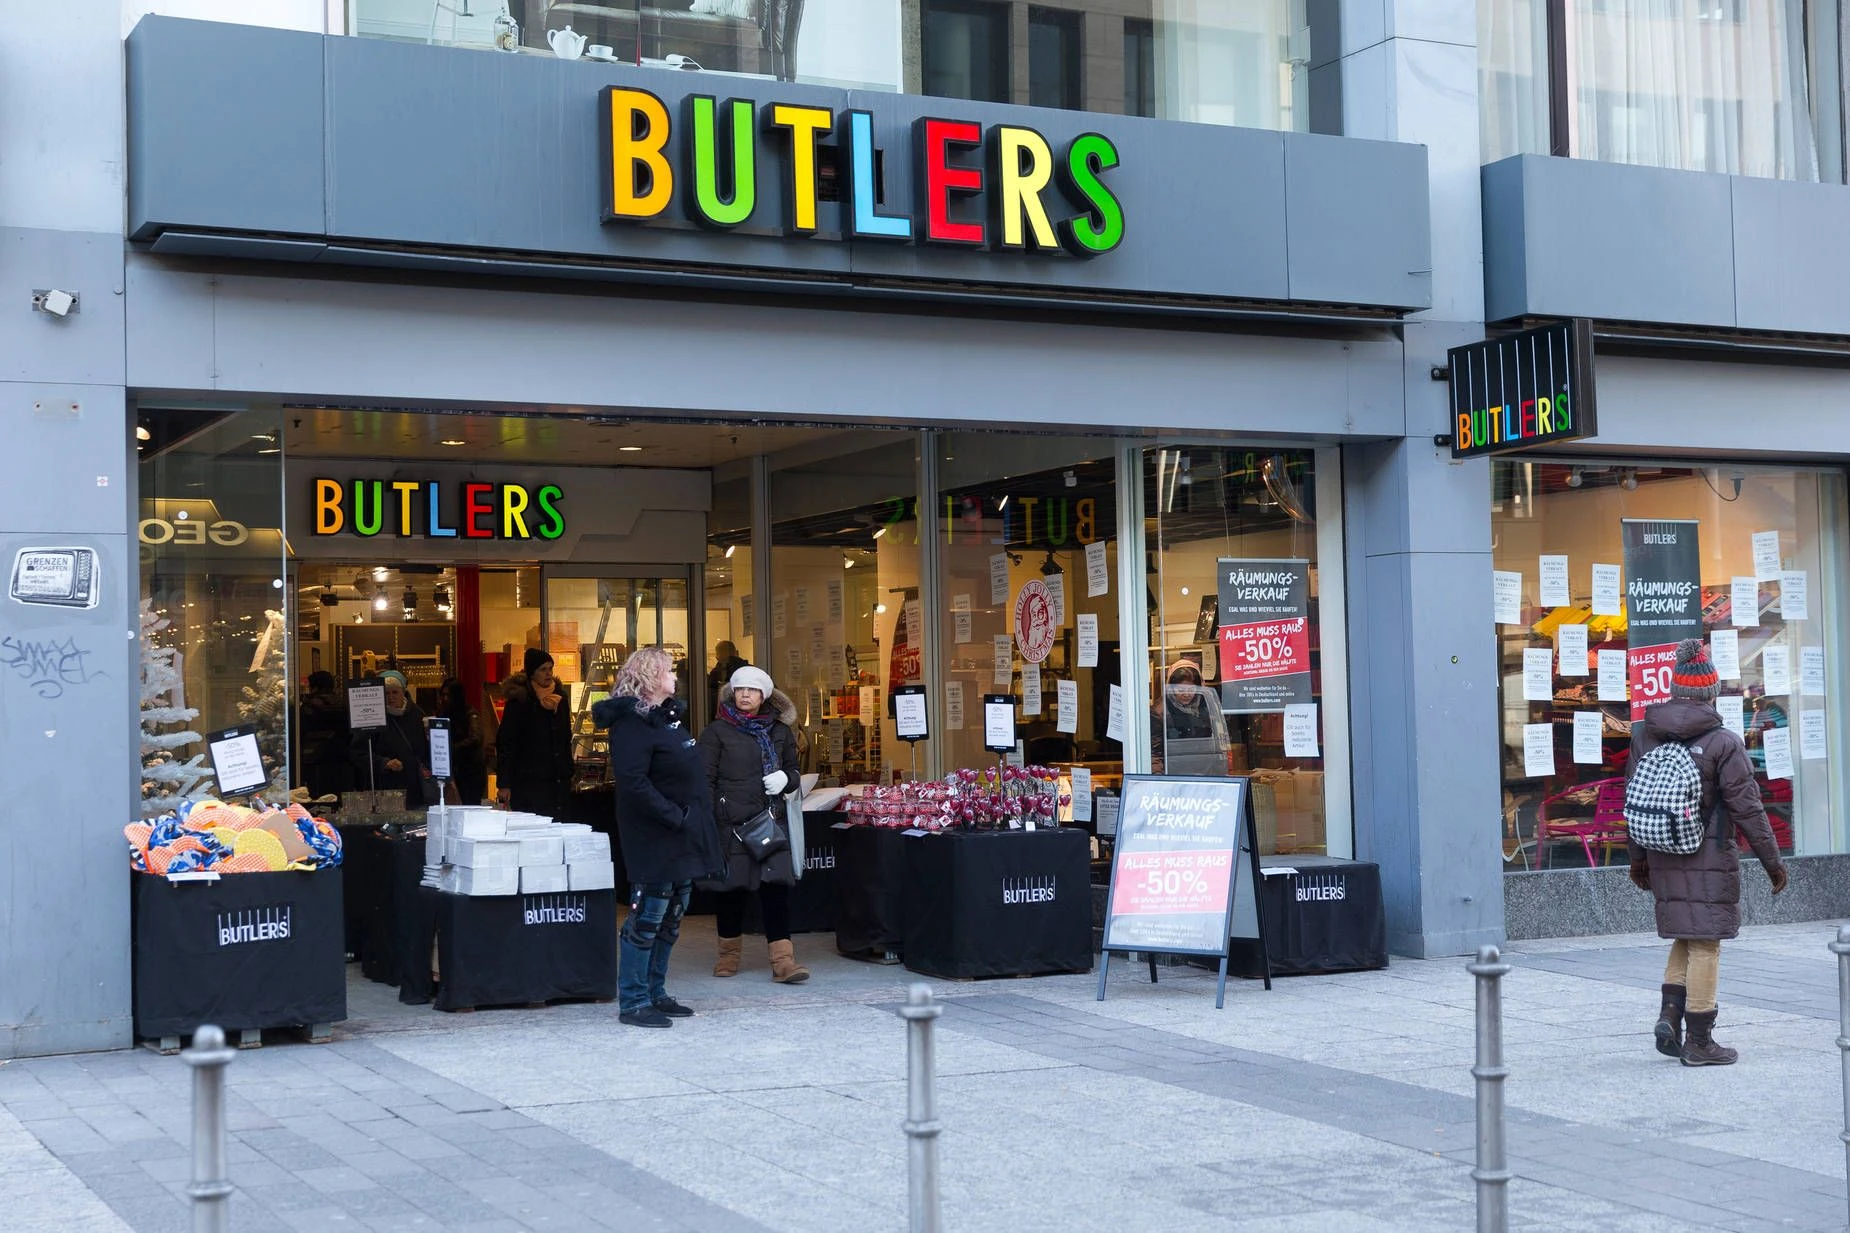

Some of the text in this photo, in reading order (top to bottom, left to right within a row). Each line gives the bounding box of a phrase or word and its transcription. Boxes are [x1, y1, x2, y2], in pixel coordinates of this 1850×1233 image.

[606, 86, 1125, 252] BUTLERS
[1457, 393, 1569, 450] BUTLERS
[314, 478, 566, 540] BUTLERS
[1643, 534, 1677, 544] BUTLERS
[26, 557, 68, 566] GRENZEN
[1229, 568, 1299, 586] RÄUMUNGS-
[1236, 587, 1290, 601] VERKAUF
[1628, 578, 1699, 597] RÄUMUNGS-
[1635, 598, 1689, 614] VERKAUF
[1225, 628, 1254, 641] ALLES
[1256, 625, 1280, 637] MUSS
[1238, 636, 1293, 662] -50%
[1630, 653, 1655, 667] ALLES
[1139, 792, 1231, 812] RÄUMUNGS-
[1146, 813, 1216, 830] VERKAUF
[1124, 855, 1228, 870] ALLES MUSS RAUS
[1137, 869, 1208, 895] -50%
[1004, 887, 1054, 904] BUTLERS
[1297, 886, 1344, 902] BUTLERS
[526, 908, 584, 924] BUTLERS
[221, 921, 288, 946] BUTLERS
